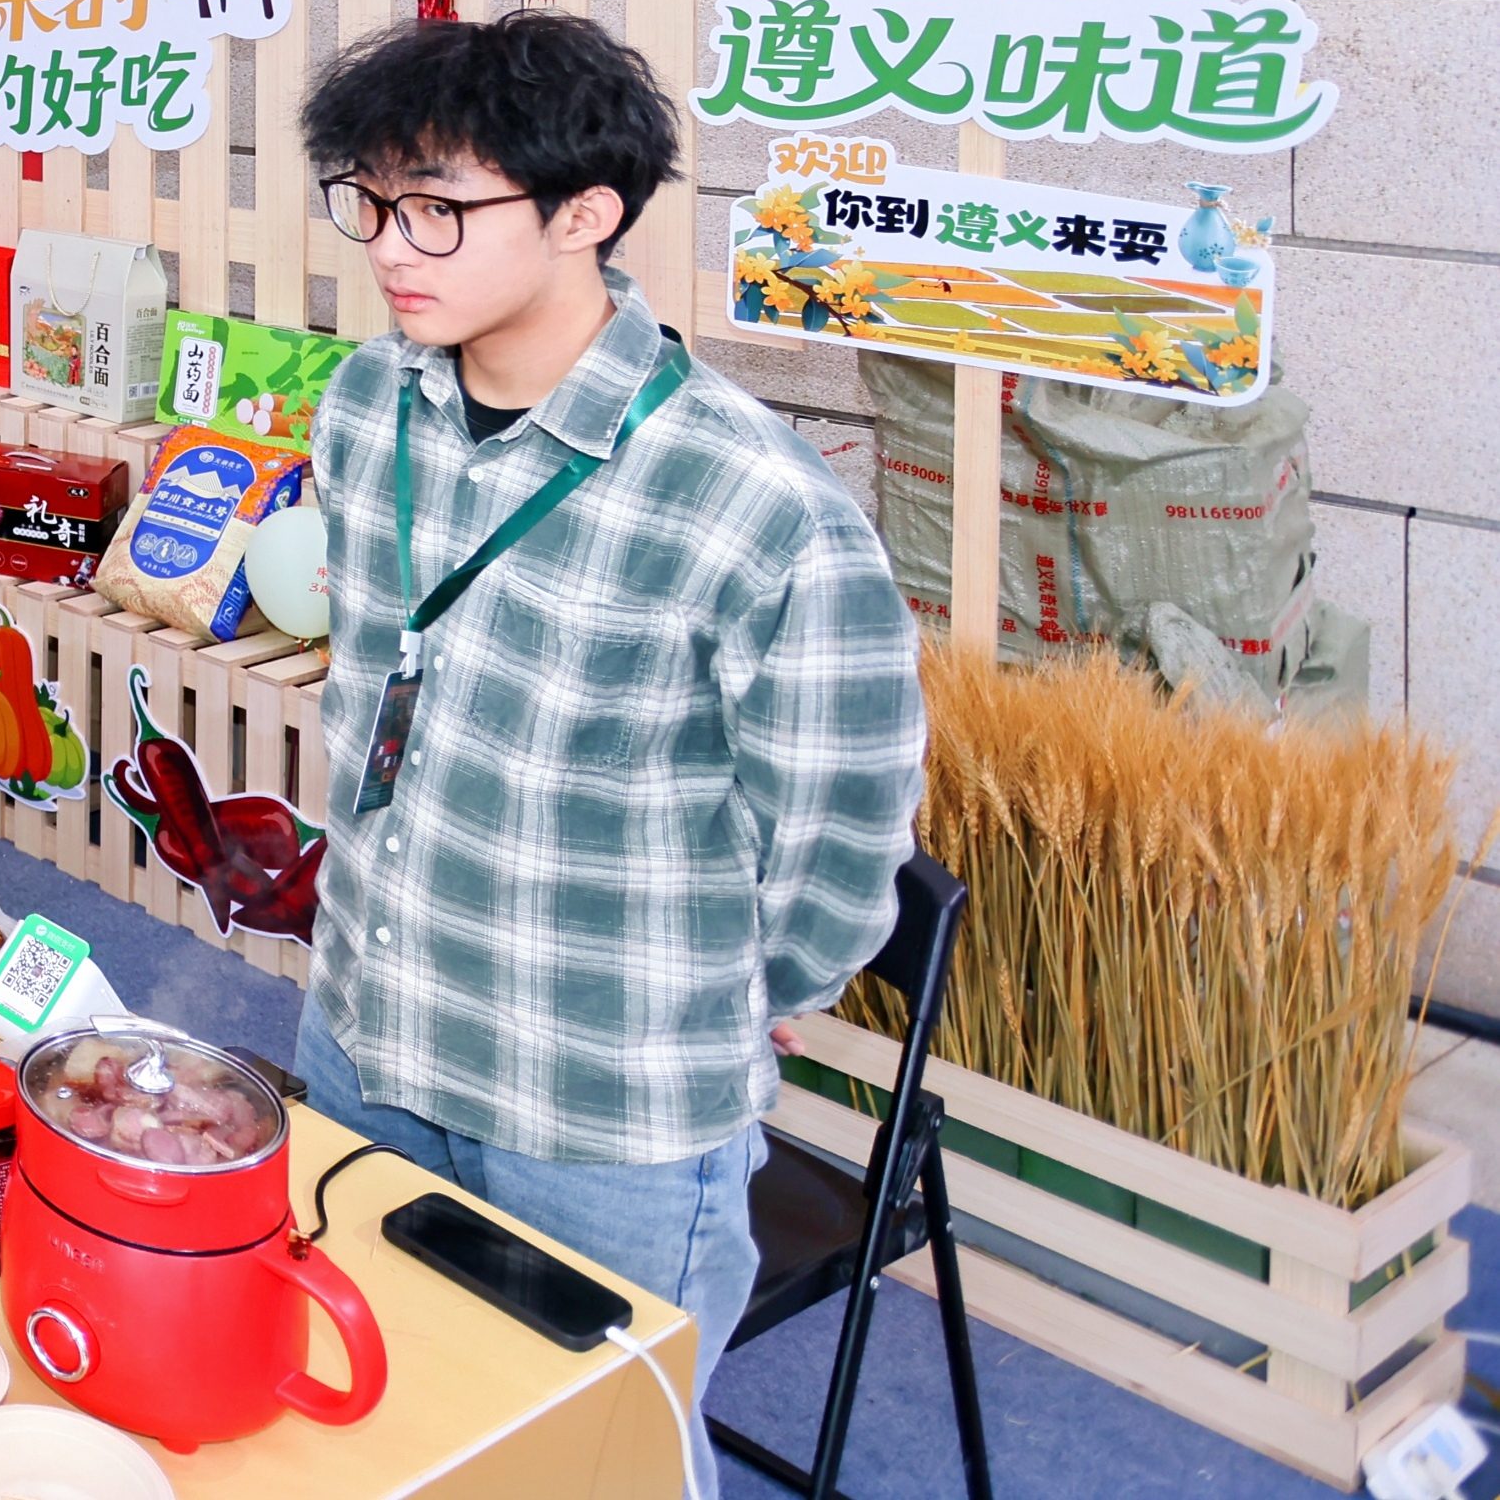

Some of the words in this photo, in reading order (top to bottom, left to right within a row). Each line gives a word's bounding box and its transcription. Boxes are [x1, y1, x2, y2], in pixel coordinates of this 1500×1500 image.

[774, 136, 888, 185] 欢迎
[824, 187, 1168, 266] 你到遵义来耍
[94, 321, 111, 388] 百合面
[182, 343, 205, 404] 山药面
[22, 493, 80, 549] 礼奇
